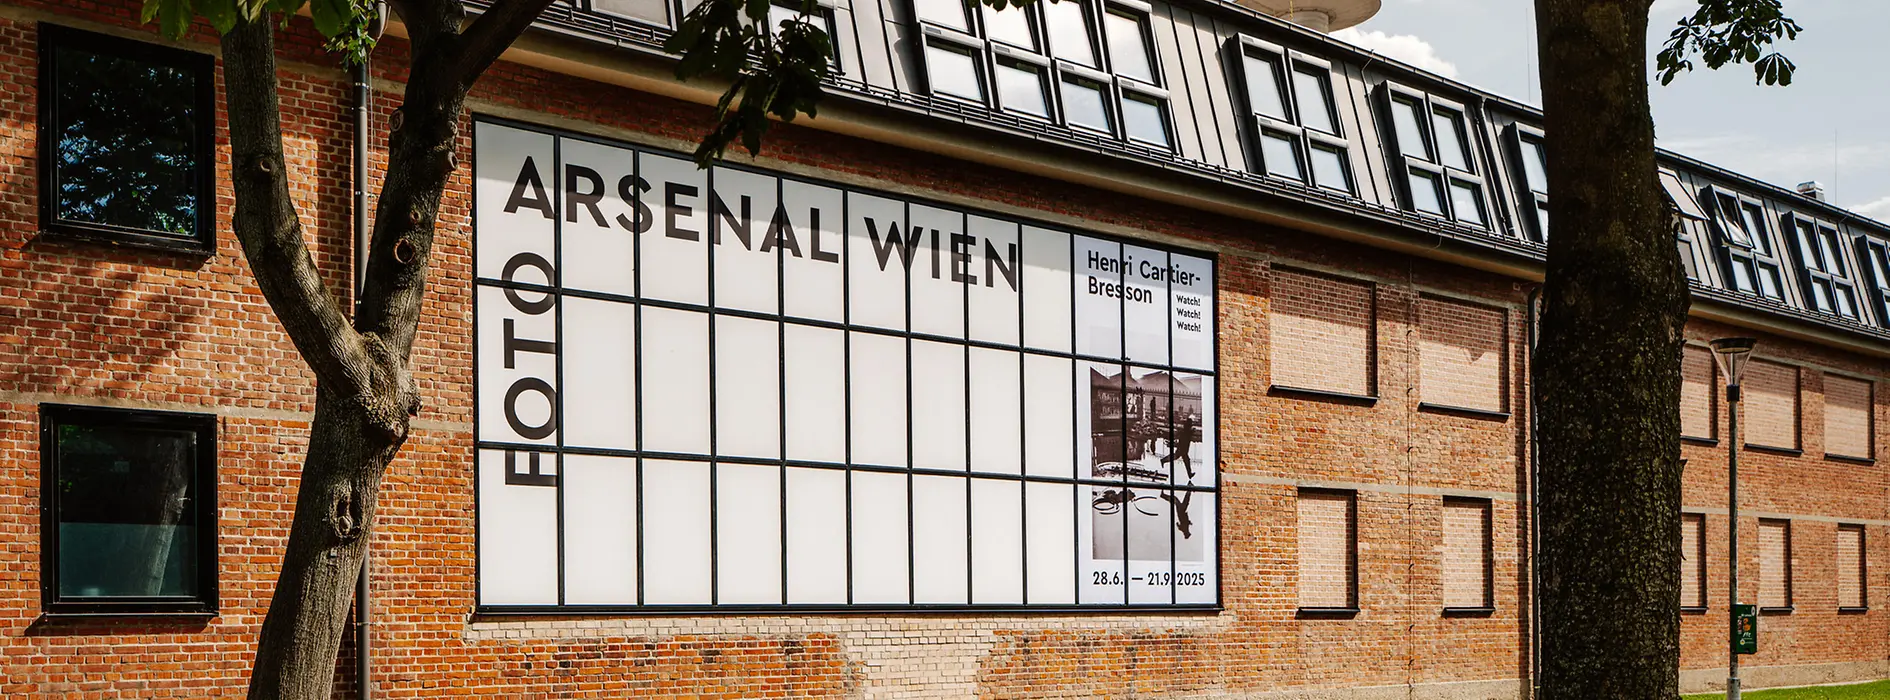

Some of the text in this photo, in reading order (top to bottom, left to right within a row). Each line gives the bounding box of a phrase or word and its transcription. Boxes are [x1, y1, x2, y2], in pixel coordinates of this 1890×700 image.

[503, 156, 1017, 292] ARSENAL WIEN
[1088, 250, 1201, 286] Henri Cartier-
[1088, 276, 1153, 304] Bresson
[1176, 294, 1201, 307] Watch!
[1176, 307, 1201, 320] Watch!
[1176, 320, 1201, 333] Watch!
[500, 251, 557, 487] FOTO
[1092, 571, 1124, 585] 28.6.
